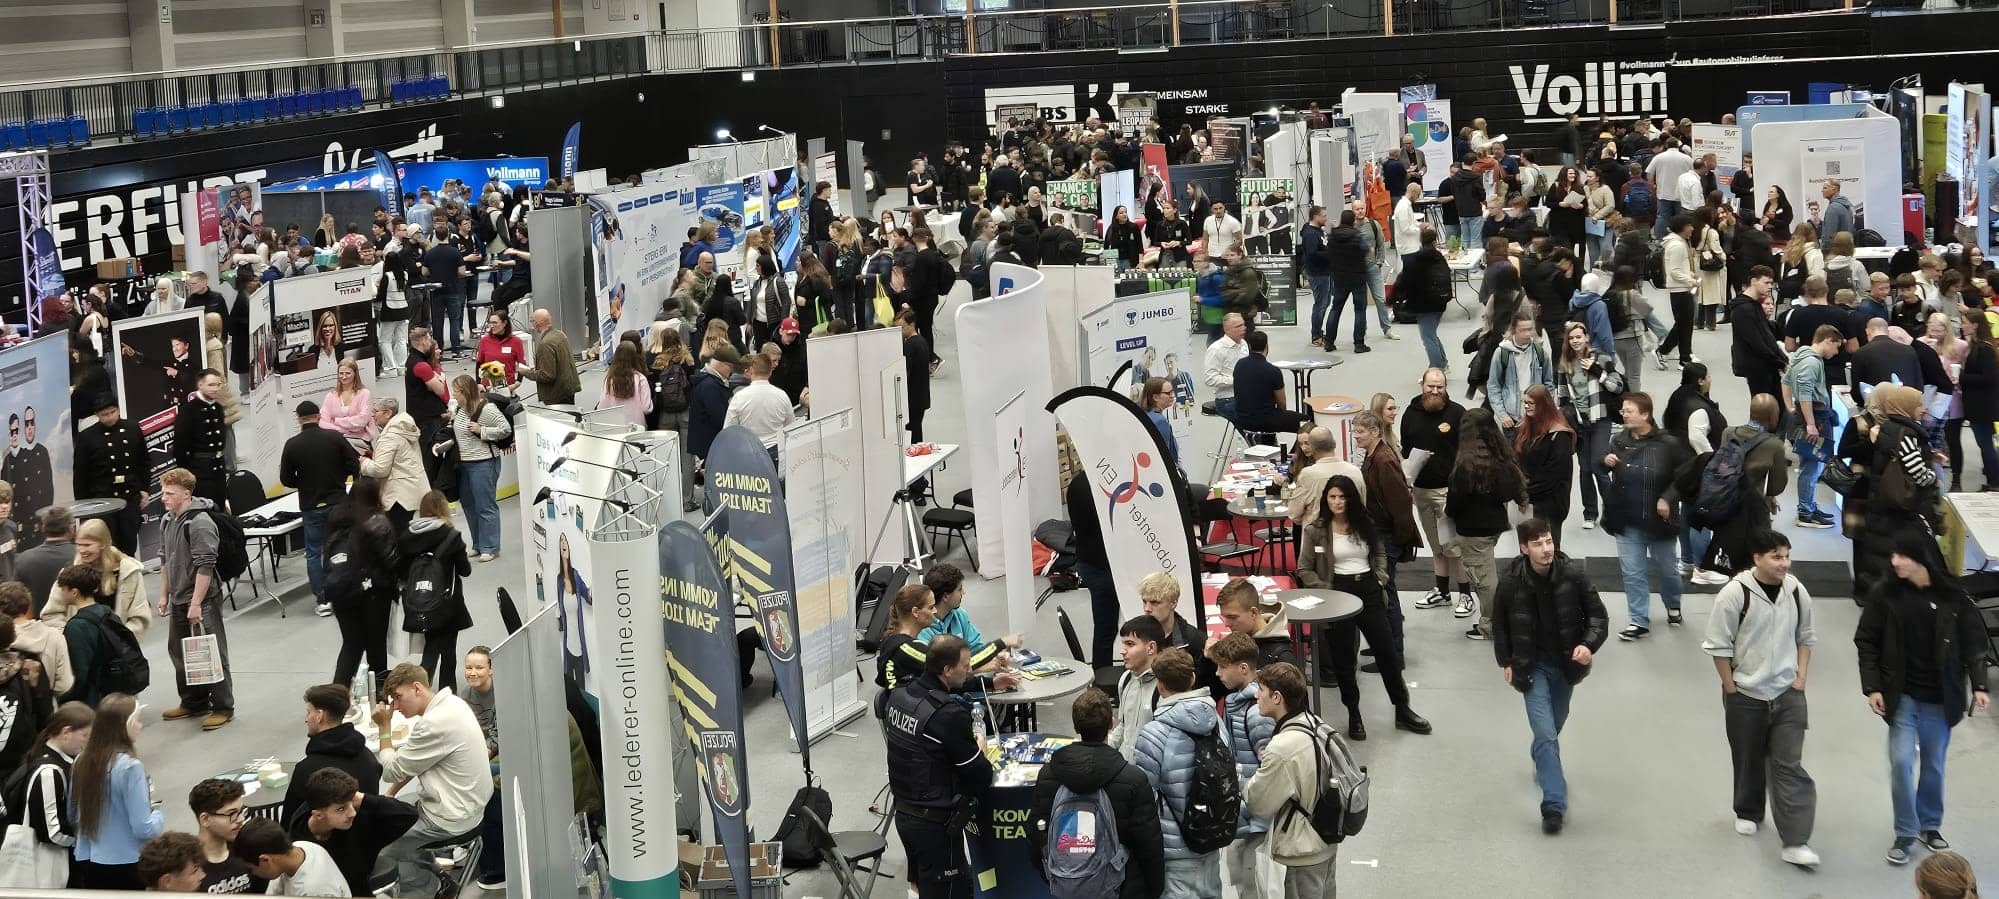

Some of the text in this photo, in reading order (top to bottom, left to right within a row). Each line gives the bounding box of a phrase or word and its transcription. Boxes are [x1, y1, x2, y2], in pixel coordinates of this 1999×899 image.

[1185, 104, 1229, 115] STARKE
[486, 167, 540, 179] Vollmann
[1047, 182, 1088, 194] CHANCE
[1241, 180, 1283, 192] FUTURE
[339, 287, 362, 295] TITAN
[1141, 307, 1174, 320] JUMBO
[1120, 340, 1136, 350] LEVEL
[885, 659, 897, 690] NRW
[615, 568, 647, 859] www.lederer-online.com
[888, 706, 919, 736] POLIZEI
[208, 873, 250, 895] adidas
